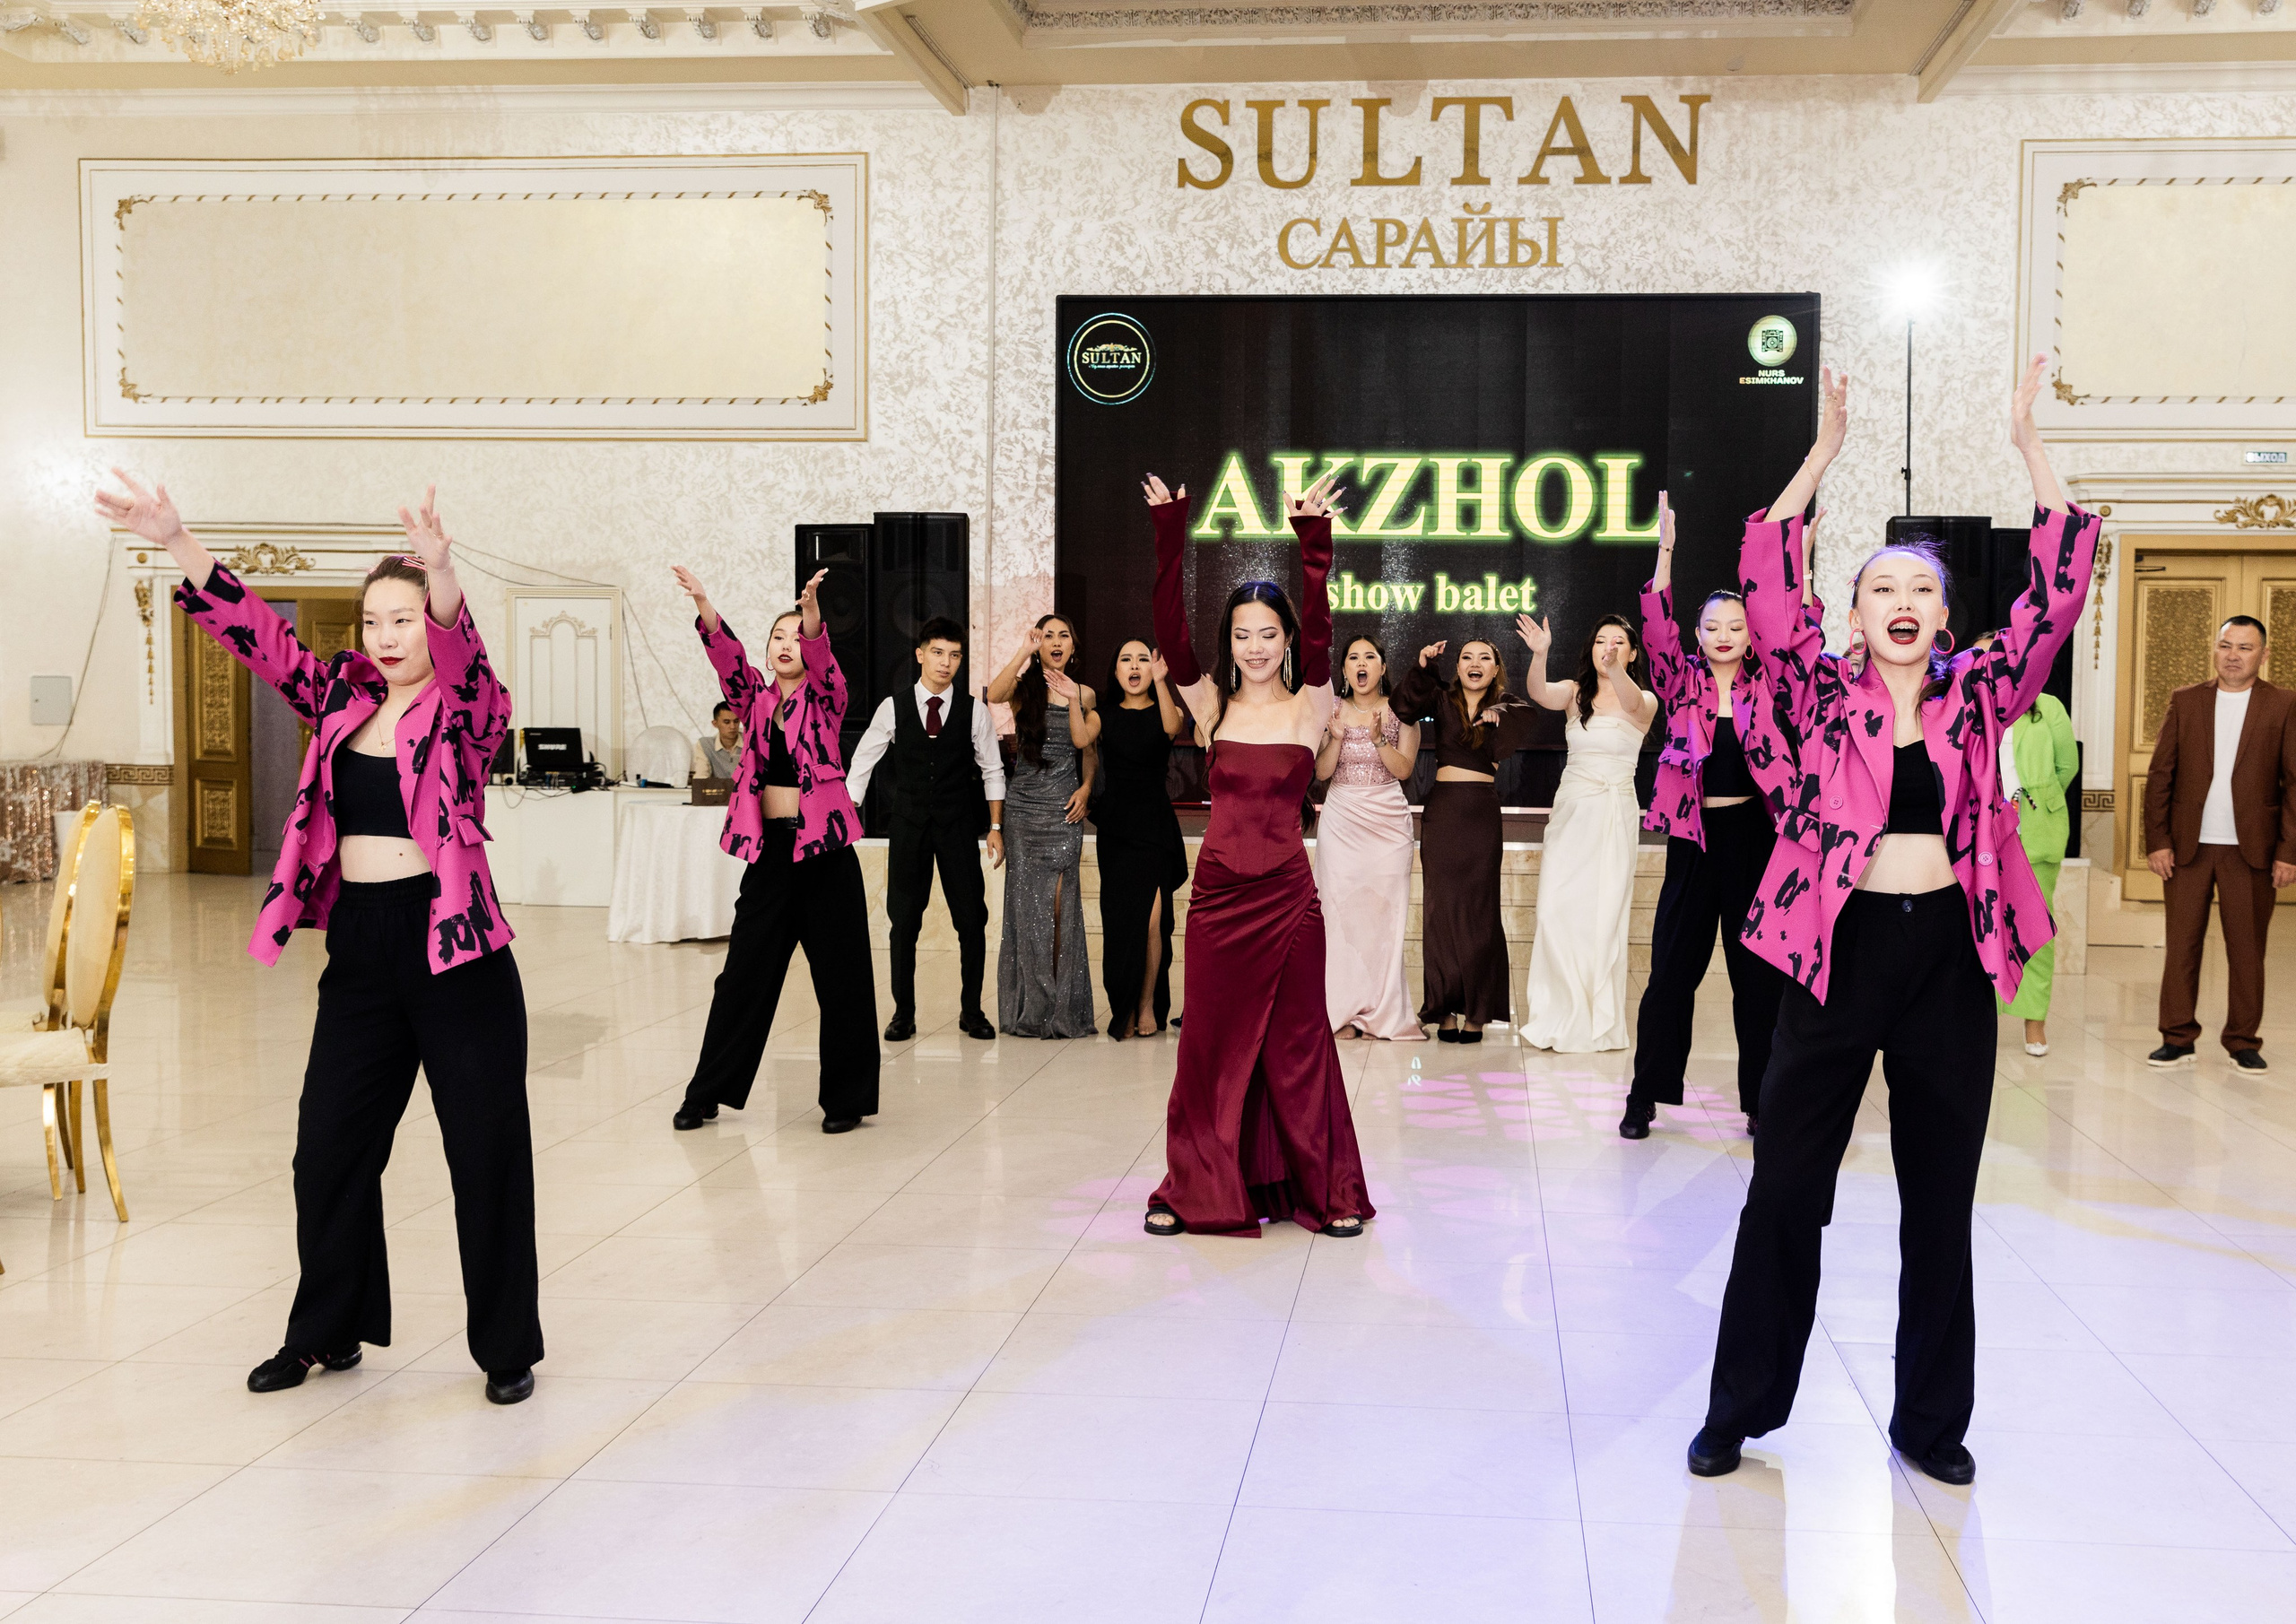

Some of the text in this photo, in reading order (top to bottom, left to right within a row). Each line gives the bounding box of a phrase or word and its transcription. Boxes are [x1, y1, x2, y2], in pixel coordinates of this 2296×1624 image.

[1178, 94, 1711, 190] SULTAN
[1277, 202, 1564, 270] САРАЙЫ
[1082, 352, 1142, 364] SULTAN
[1758, 369, 1786, 378] NURS
[1193, 454, 1661, 539] AKZHOL
[1327, 572, 1537, 612] show balet
